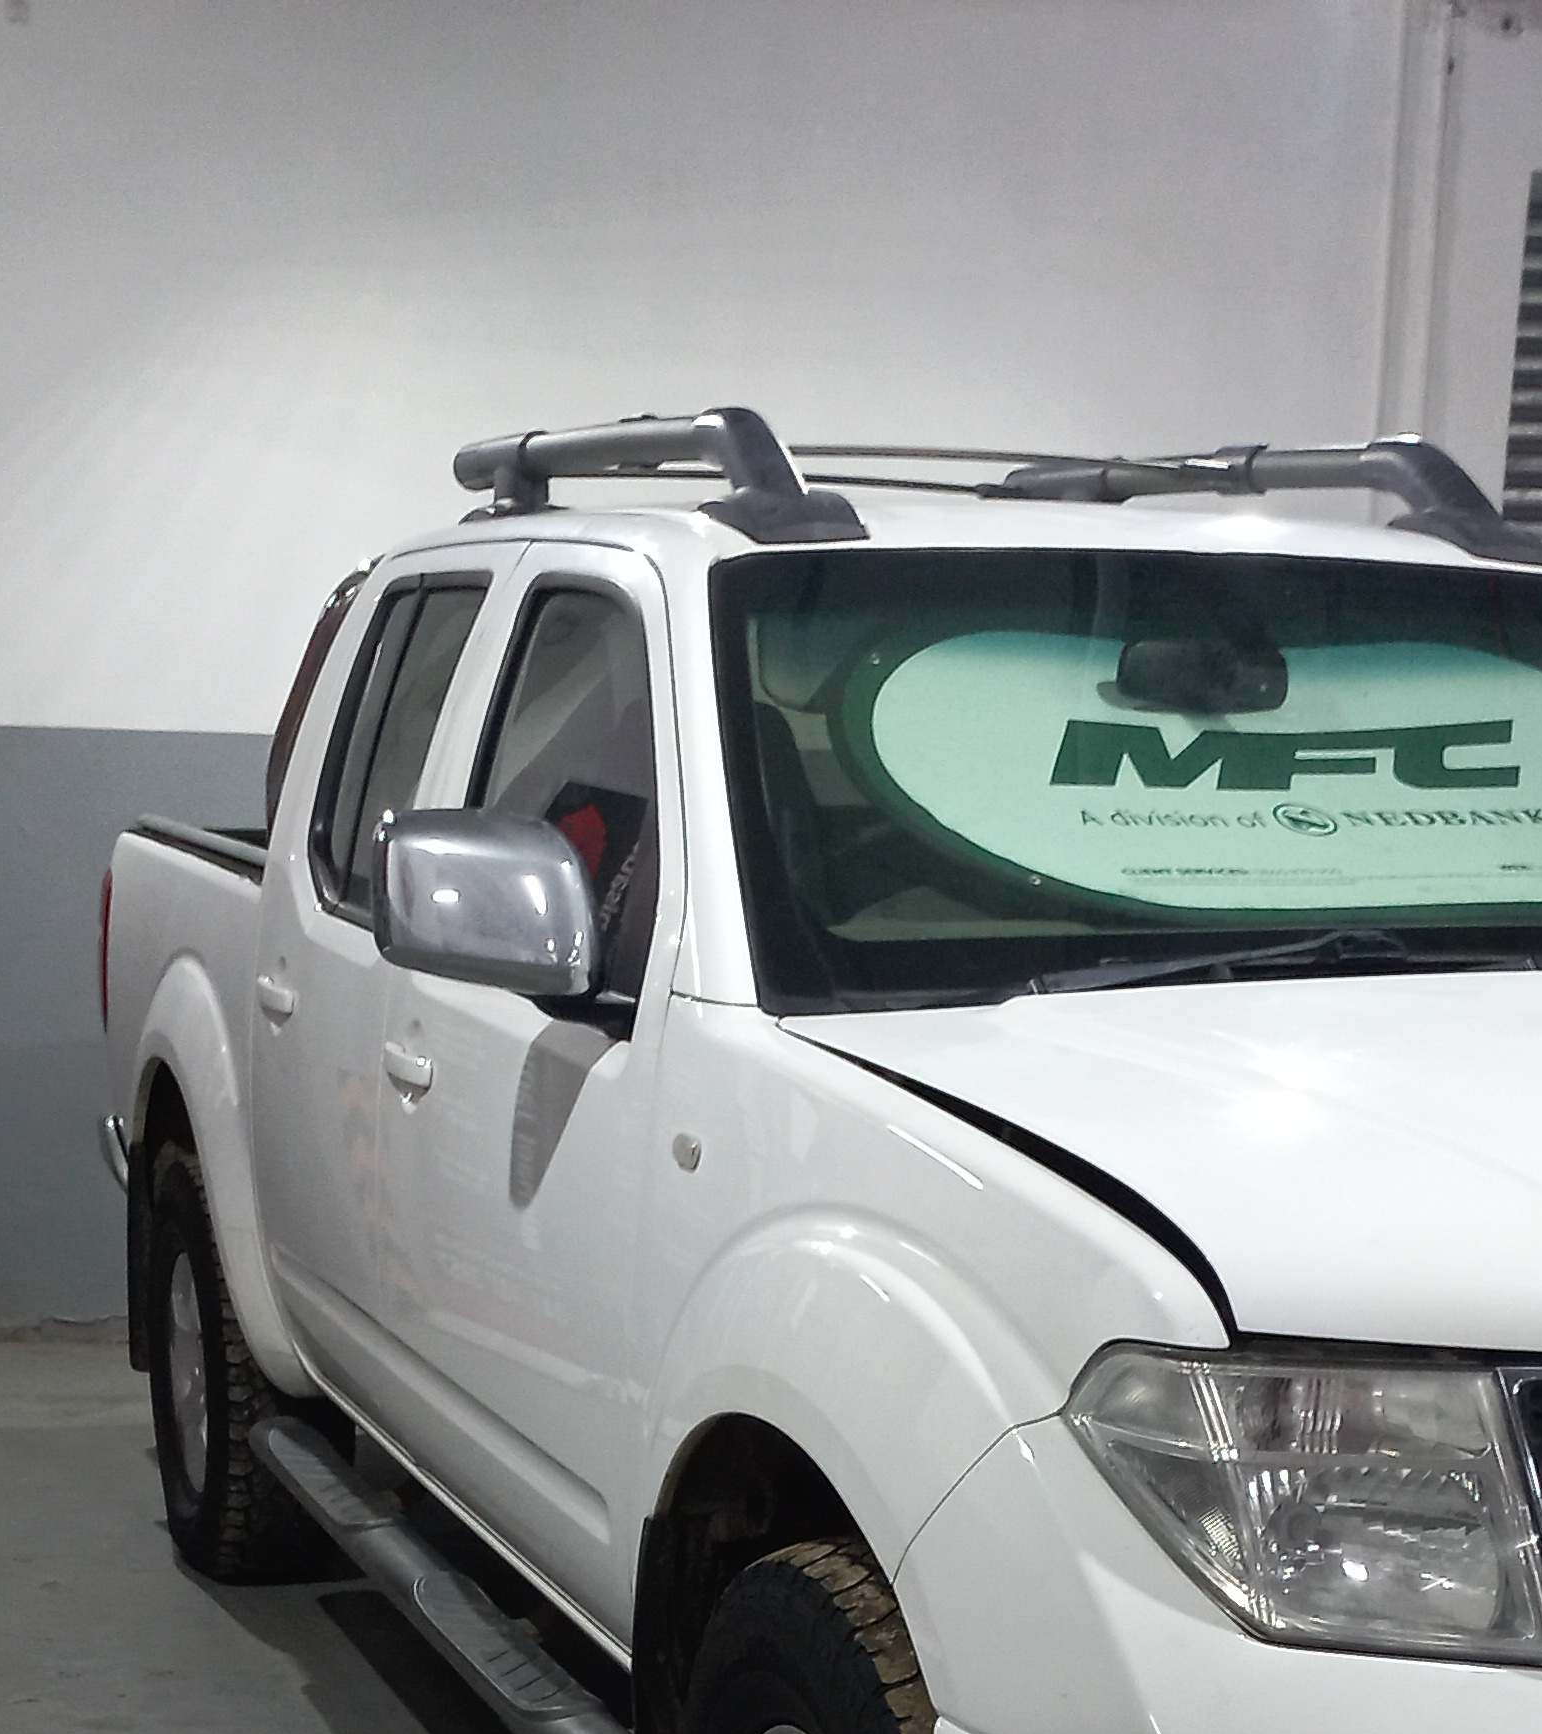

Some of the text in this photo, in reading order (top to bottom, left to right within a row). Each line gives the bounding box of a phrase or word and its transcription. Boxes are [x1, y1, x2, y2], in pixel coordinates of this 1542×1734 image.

[1049, 719, 1521, 791] MFC
[1080, 809, 1267, 830] A division of
